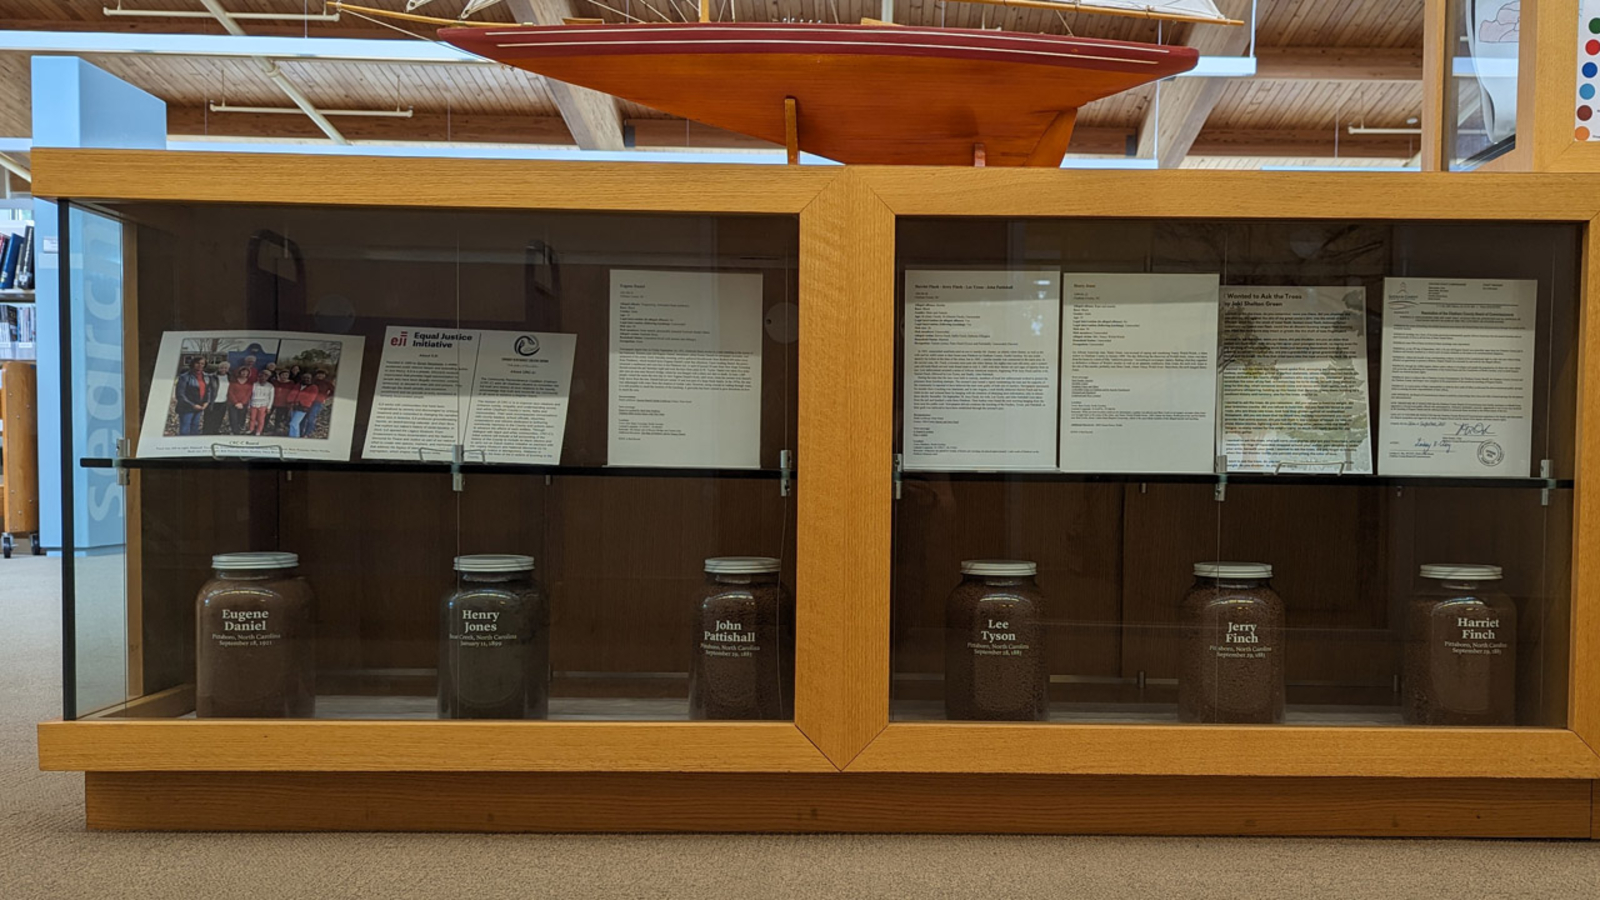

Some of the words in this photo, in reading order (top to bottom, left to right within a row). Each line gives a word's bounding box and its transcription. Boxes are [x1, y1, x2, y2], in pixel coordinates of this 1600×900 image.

[414, 331, 440, 341] Equal
[412, 340, 453, 349] Initiative
[222, 609, 269, 622] Eugene
[462, 609, 500, 622] Henry
[224, 620, 267, 631] Daniel
[464, 621, 497, 634] Jones
[715, 620, 742, 632] John
[988, 619, 1009, 629] Lee
[1228, 622, 1257, 633] Jerry
[1457, 617, 1500, 628] Harriet
[704, 631, 756, 642] Pattishall
[980, 630, 1016, 643] Tyson
[1225, 631, 1259, 643] Finch
[1462, 629, 1496, 640] Finch
